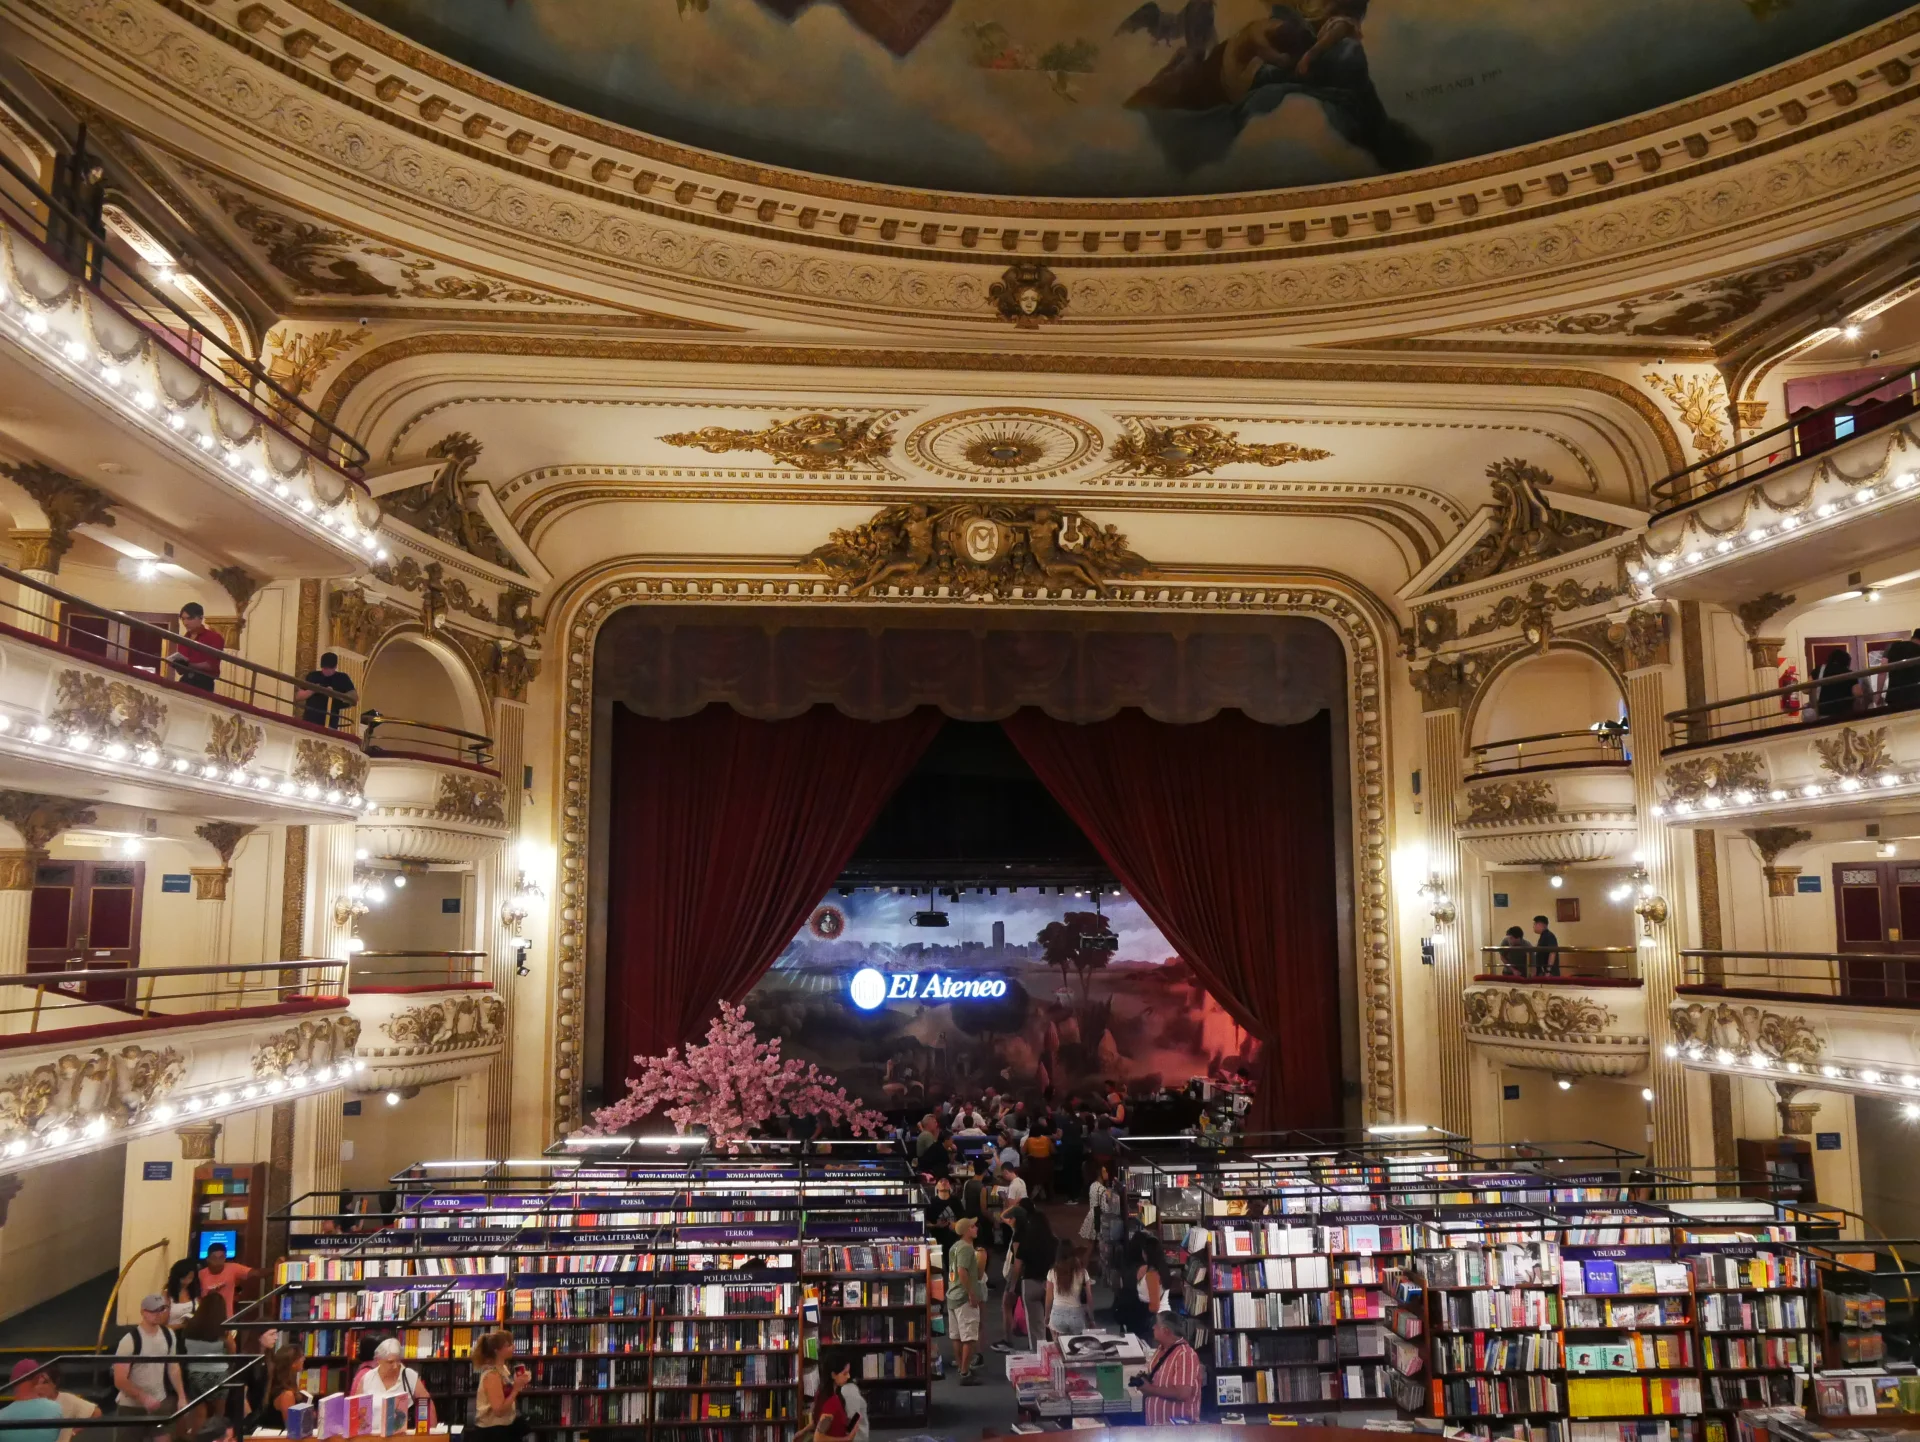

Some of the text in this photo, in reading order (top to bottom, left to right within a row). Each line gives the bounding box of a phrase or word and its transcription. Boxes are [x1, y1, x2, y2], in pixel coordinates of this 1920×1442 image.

[887, 972, 1007, 999] El Ateneo
[1482, 1178, 1502, 1187] GUÍAS
[1588, 1176, 1603, 1184] VIAJE
[521, 1198, 544, 1206] POESÍA
[1335, 1214, 1376, 1222] MARKETING
[724, 1229, 754, 1237] TERROR
[849, 1225, 879, 1233] TERROR
[314, 1236, 348, 1245] CRÍTICA
[447, 1233, 478, 1242] CRÍTICA
[573, 1232, 650, 1242] CRÍTICA LITERARIA
[1592, 1249, 1627, 1258] VISUALES
[1720, 1247, 1754, 1255] VISUALES
[703, 1273, 753, 1283] POLICIALES
[1588, 1271, 1614, 1281] CULT
[559, 1276, 611, 1286] POLICIALES
